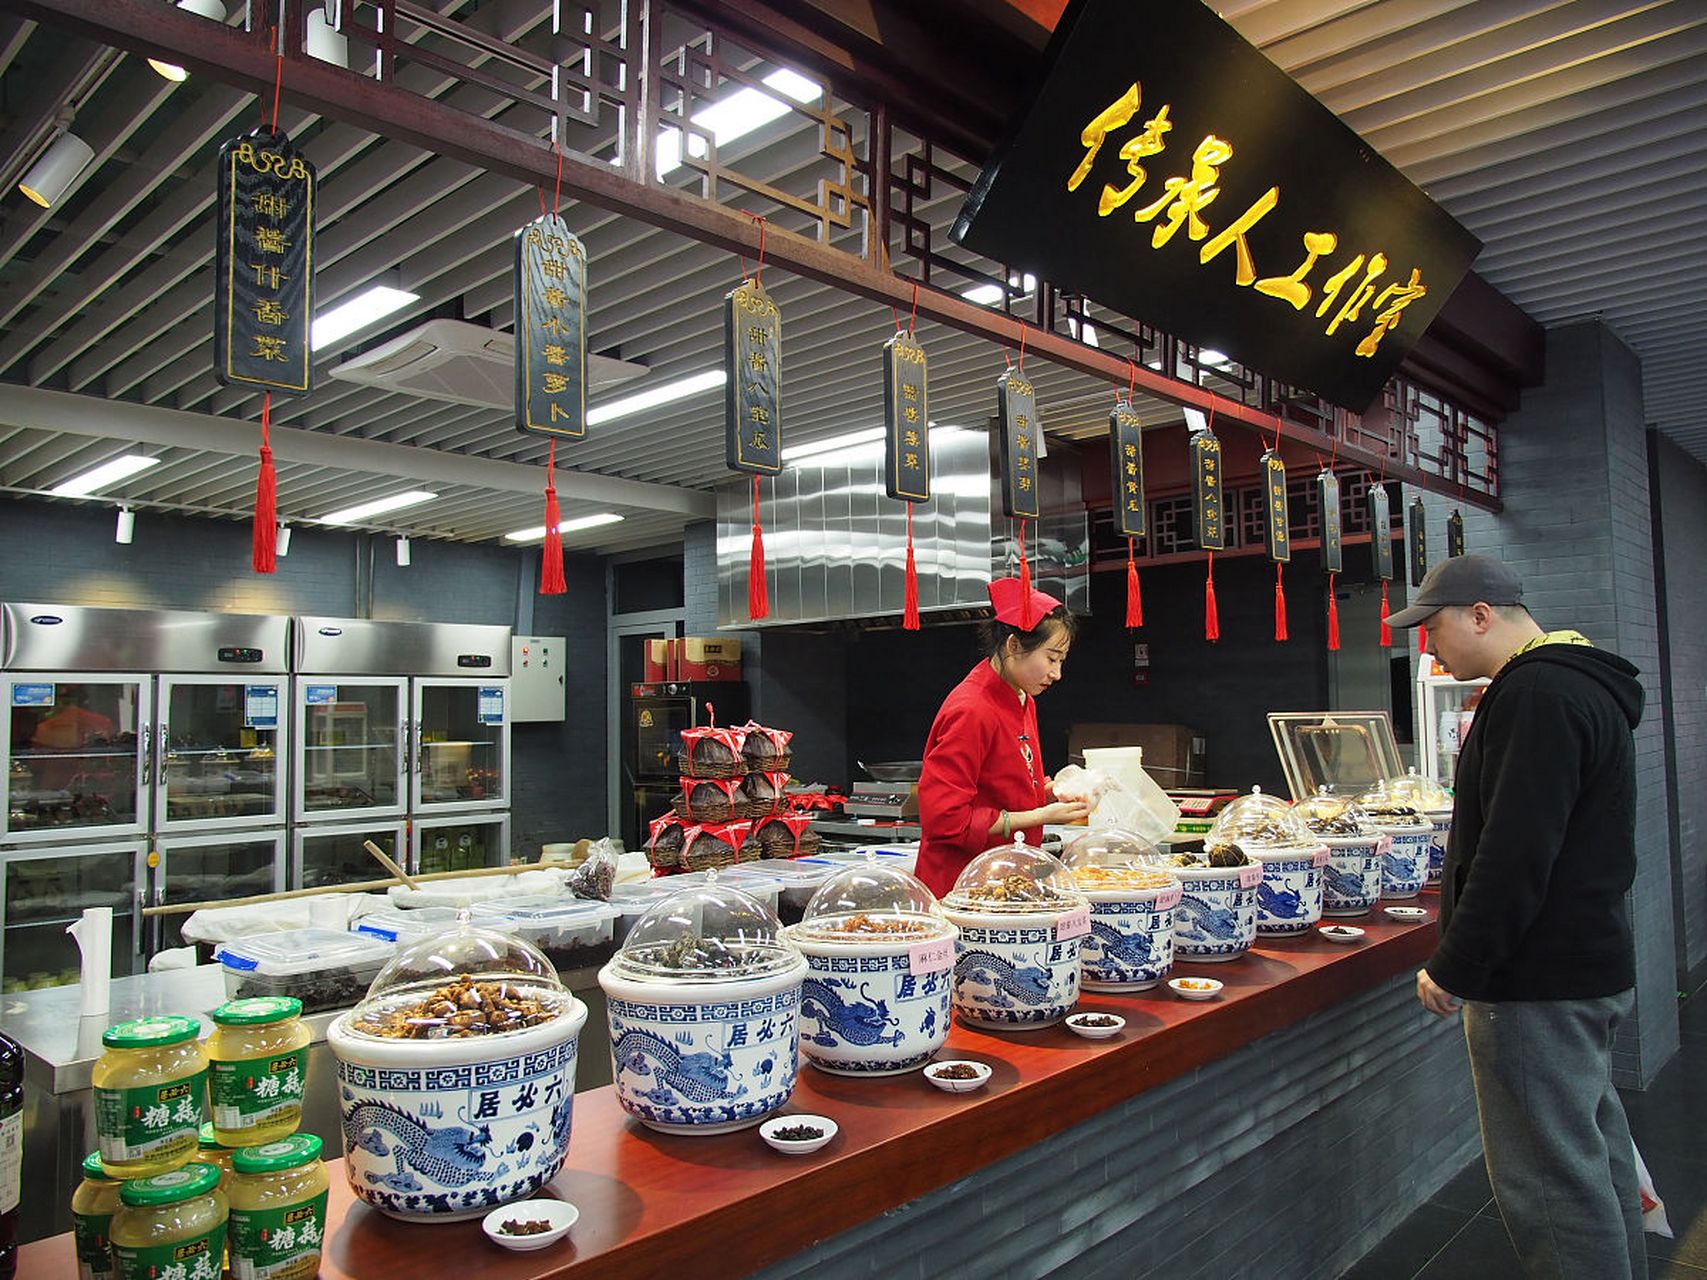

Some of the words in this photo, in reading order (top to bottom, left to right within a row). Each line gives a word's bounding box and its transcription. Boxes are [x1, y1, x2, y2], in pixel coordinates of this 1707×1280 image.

[727, 1013, 795, 1048] 六必居
[253, 1067, 305, 1098] 糖蒜
[474, 1074, 563, 1120] 六必居
[140, 1094, 201, 1129] 糖蒜
[268, 1215, 324, 1250] 糖蒜
